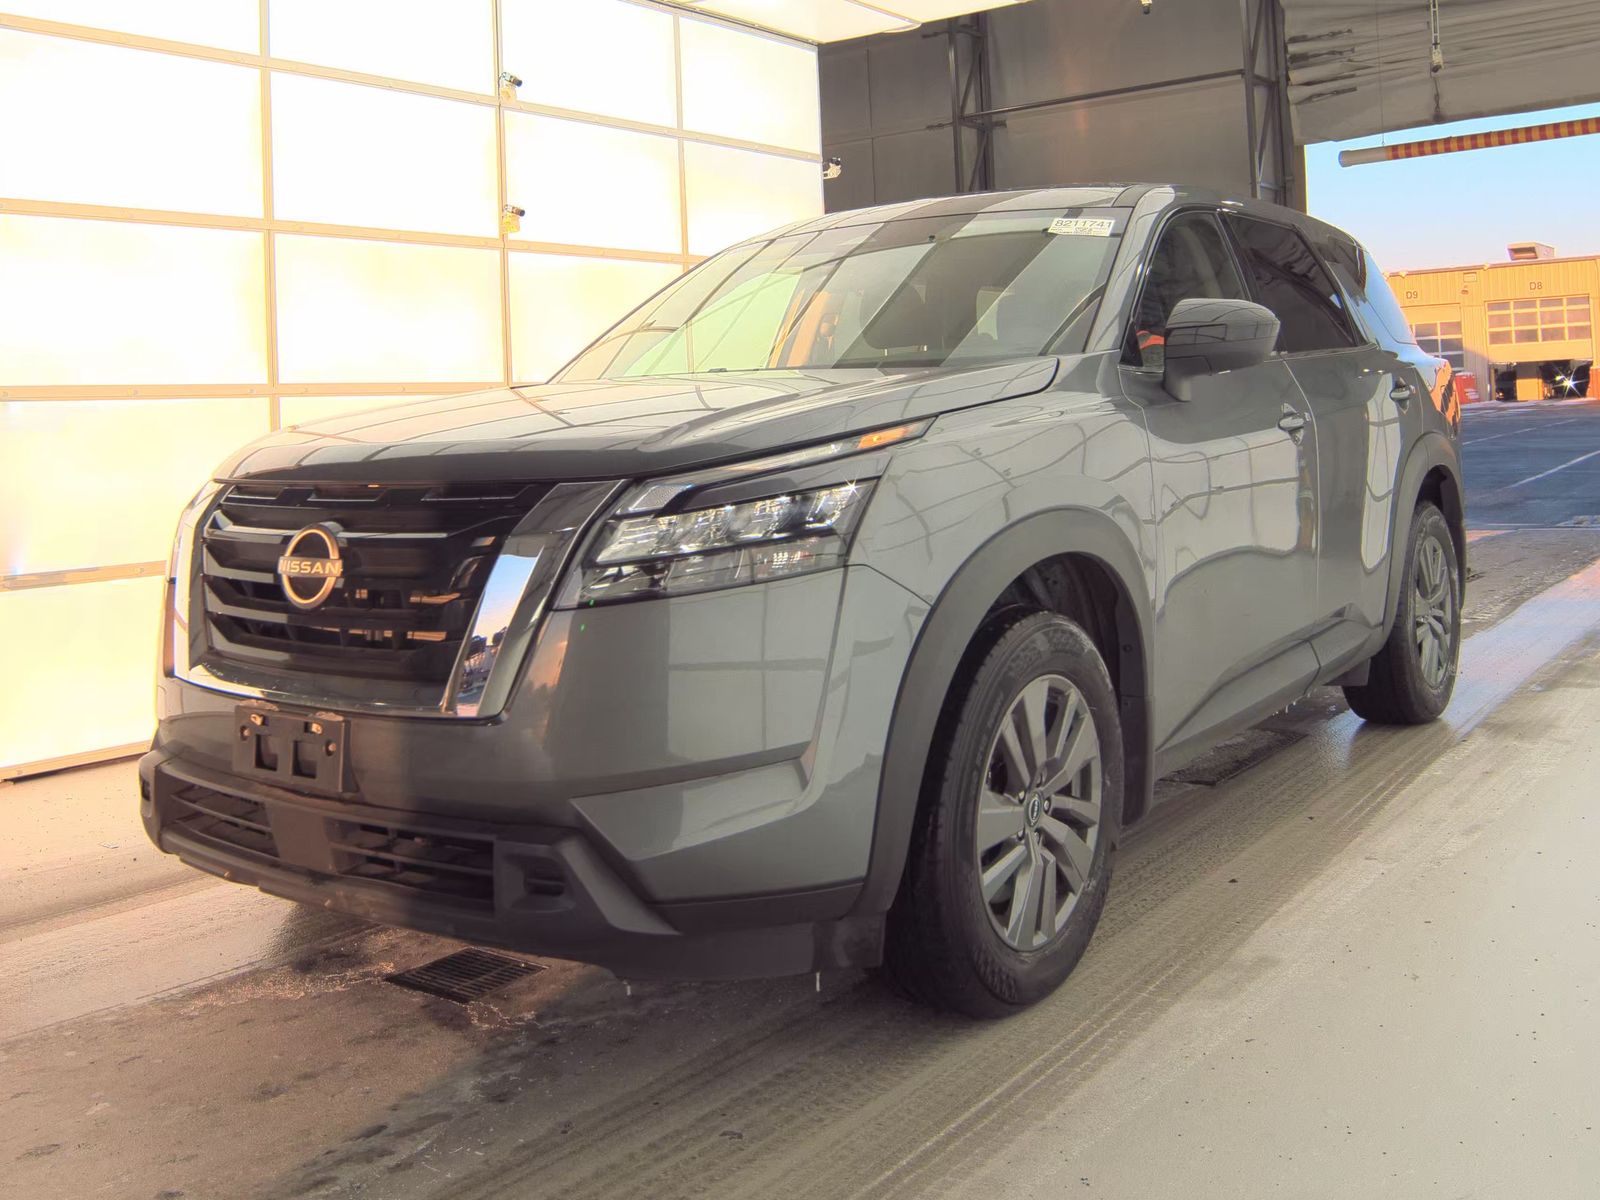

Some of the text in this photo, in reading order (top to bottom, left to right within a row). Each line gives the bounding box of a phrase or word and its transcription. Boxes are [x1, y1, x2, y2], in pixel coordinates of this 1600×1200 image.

[1054, 219, 1112, 228] 8211741
[1529, 281, 1543, 290] D8
[1405, 290, 1418, 299] D9
[279, 559, 340, 574] NISSAN
